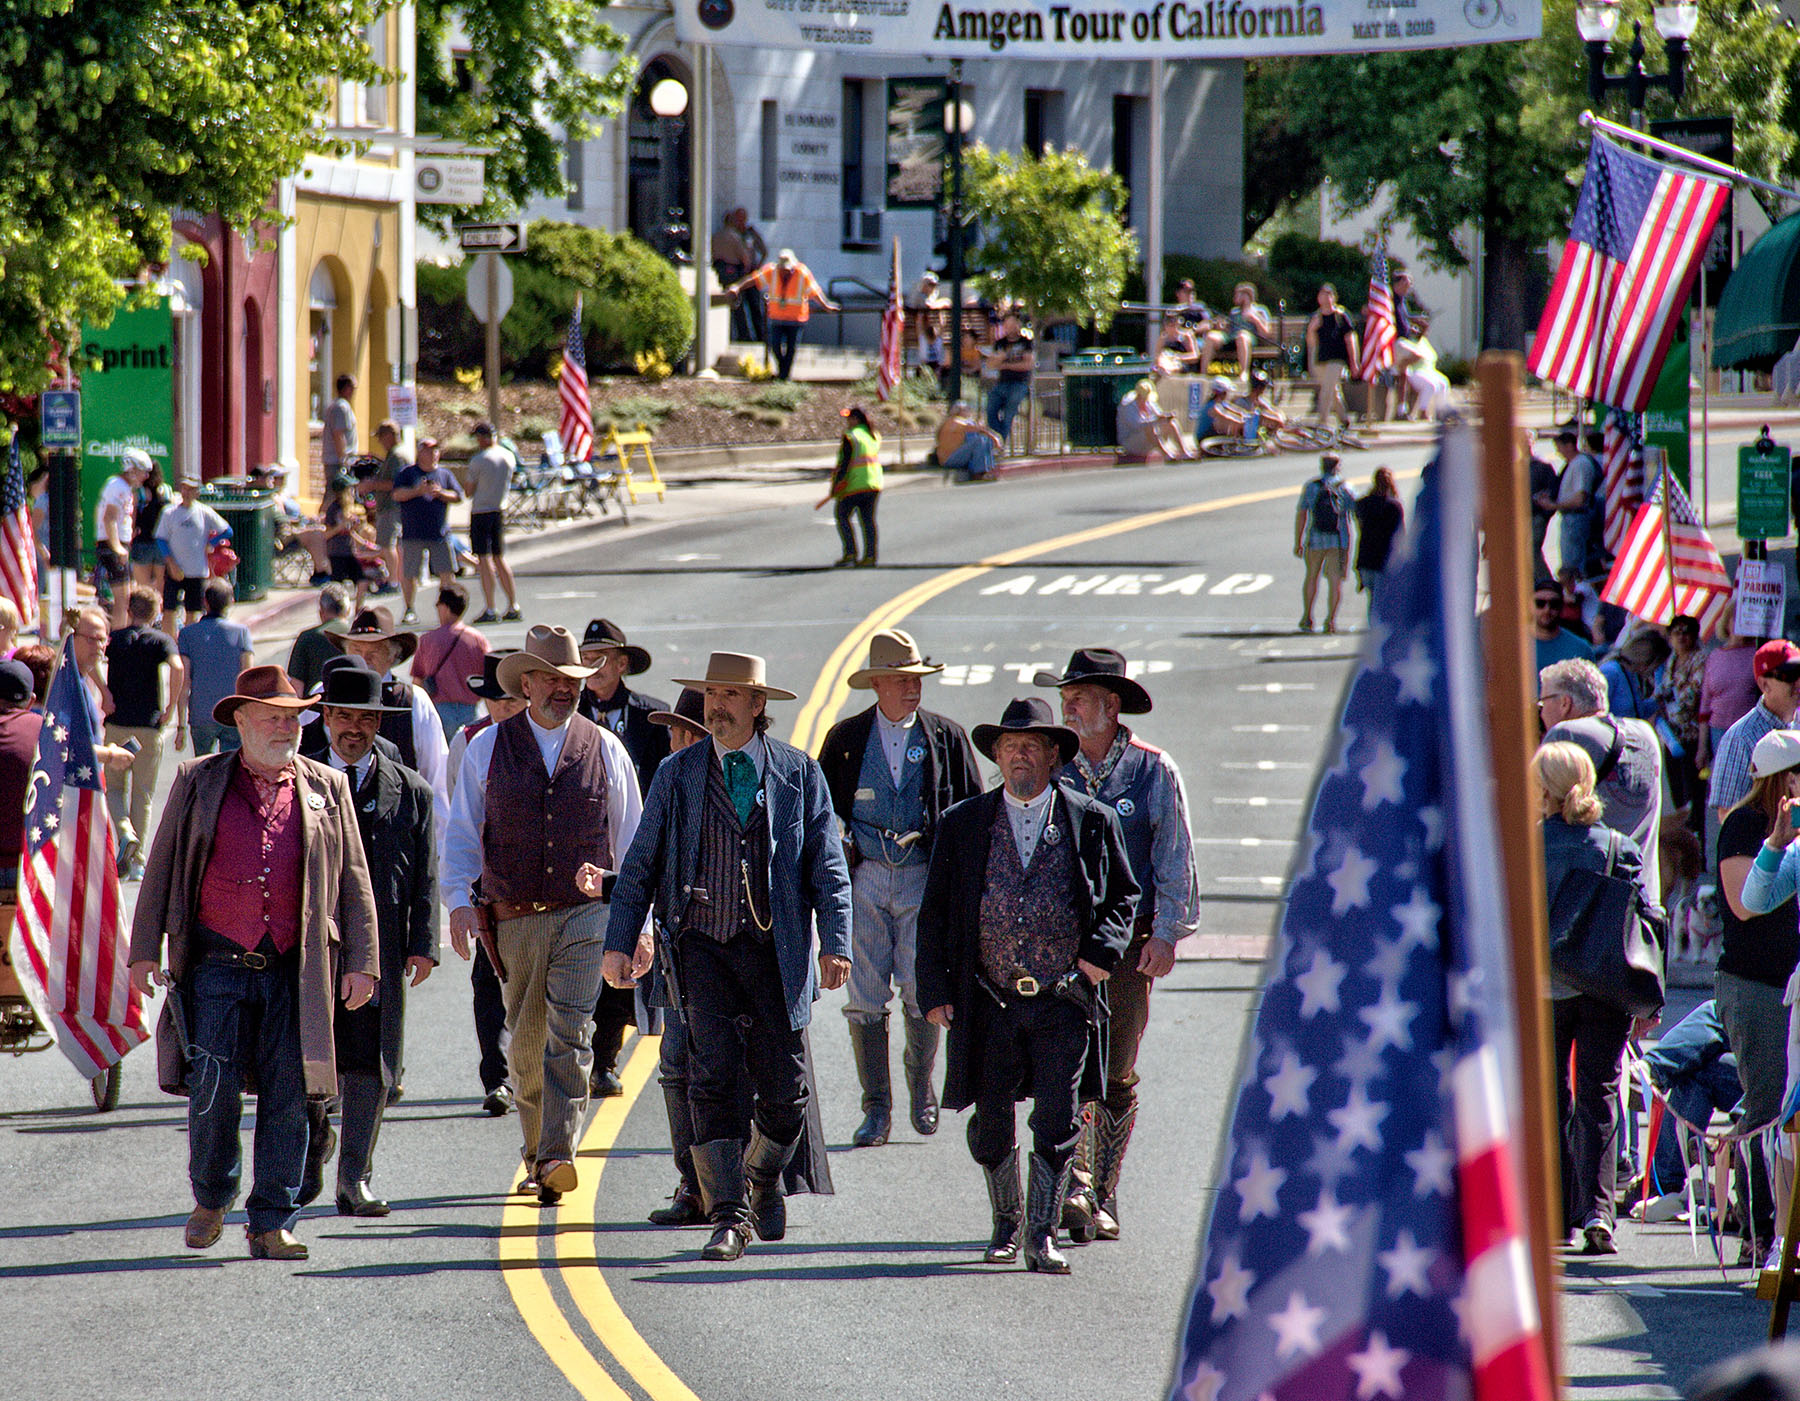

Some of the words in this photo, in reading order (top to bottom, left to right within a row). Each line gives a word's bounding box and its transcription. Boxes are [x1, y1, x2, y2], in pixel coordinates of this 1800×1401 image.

[934, 3, 1044, 51] Amgen
[1051, 7, 1126, 42] Tour
[1132, 2, 1164, 41] of
[1169, 0, 1325, 41] California
[85, 344, 168, 373] Sprint
[979, 573, 1275, 596] AHEAD
[1744, 581, 1782, 595] PARKING
[939, 660, 1174, 686] STP
